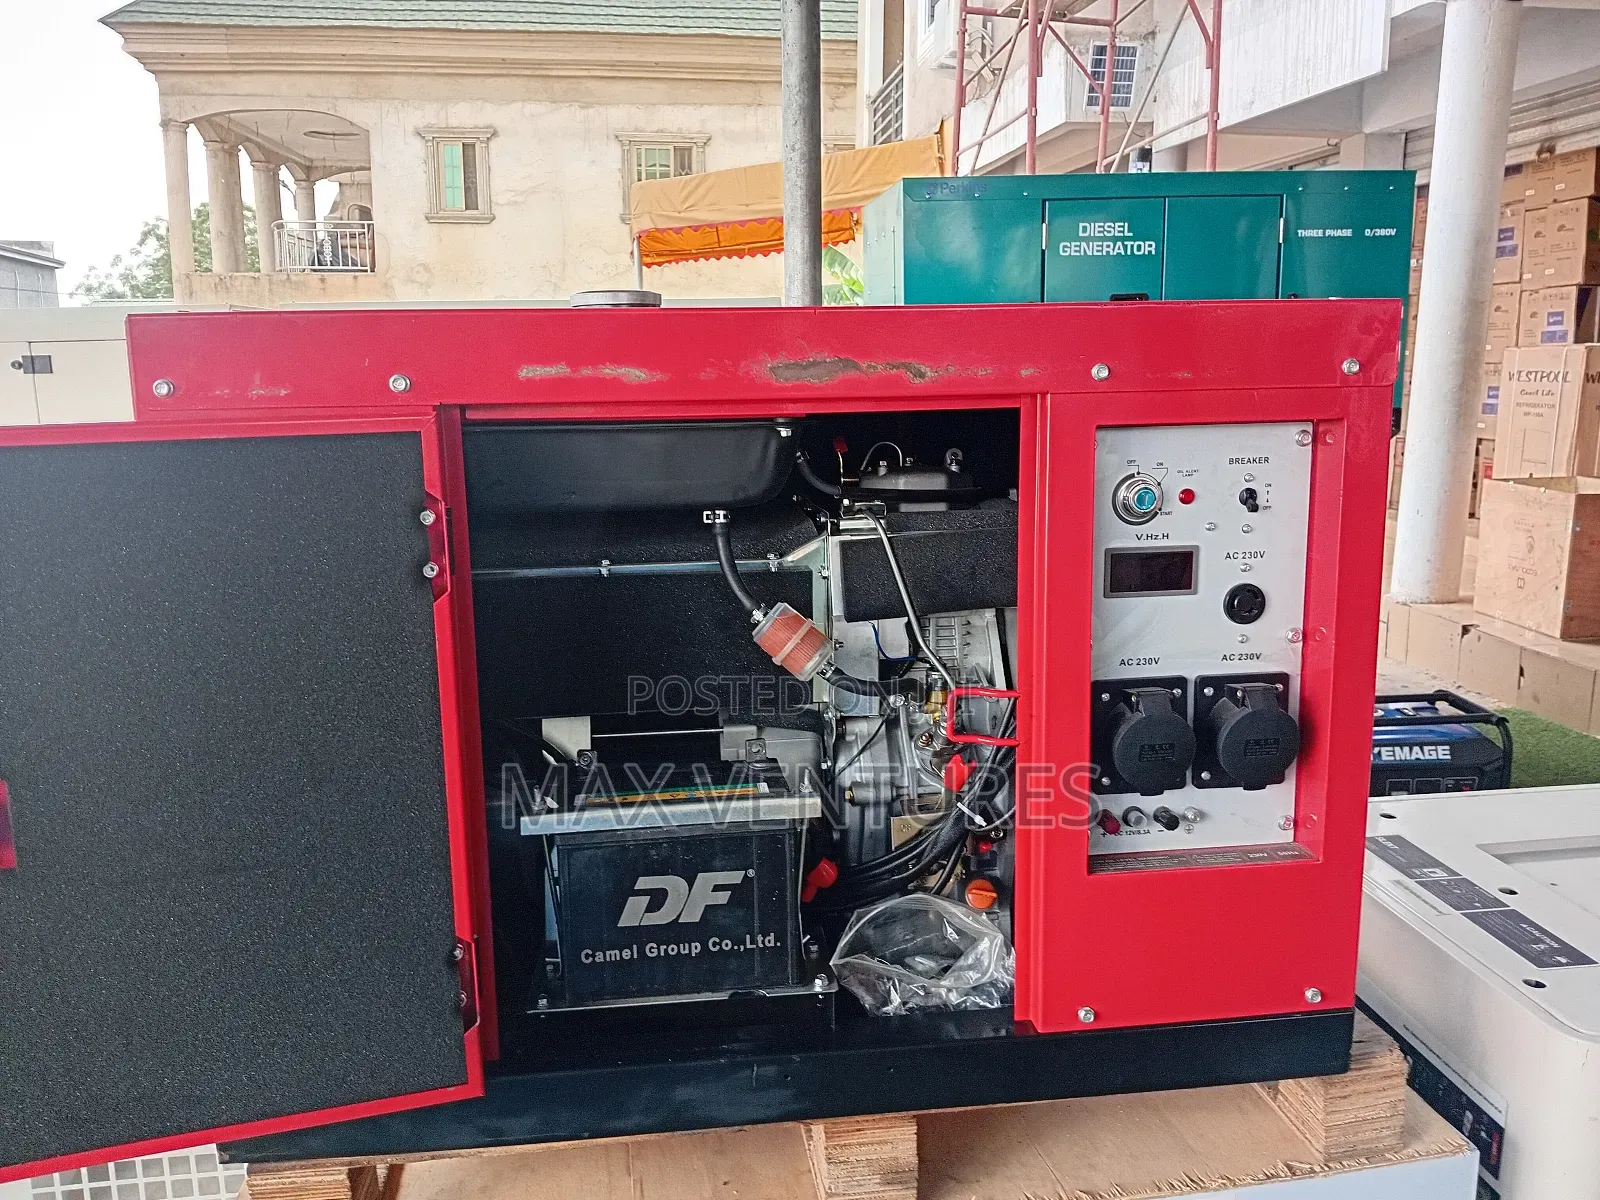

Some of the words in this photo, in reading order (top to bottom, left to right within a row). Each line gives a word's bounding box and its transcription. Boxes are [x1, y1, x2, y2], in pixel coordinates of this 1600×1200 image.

[939, 181, 988, 195] Perkins
[1078, 222, 1133, 237] DIESEL
[1297, 229, 1324, 237] THREE
[1325, 229, 1353, 237] PHASE
[1059, 241, 1156, 256] GENERATOR
[1228, 456, 1270, 465] BREAKER
[1224, 551, 1239, 560] AC
[1241, 550, 1266, 560] 230V
[1119, 658, 1134, 667] AC
[1135, 657, 1161, 666] 230V
[1221, 654, 1235, 662] AC
[1237, 652, 1262, 661] 230V
[617, 870, 746, 927] DF
[580, 944, 638, 964] Camel
[644, 941, 701, 958] Group
[708, 932, 781, 953] Co.,Ltd.
